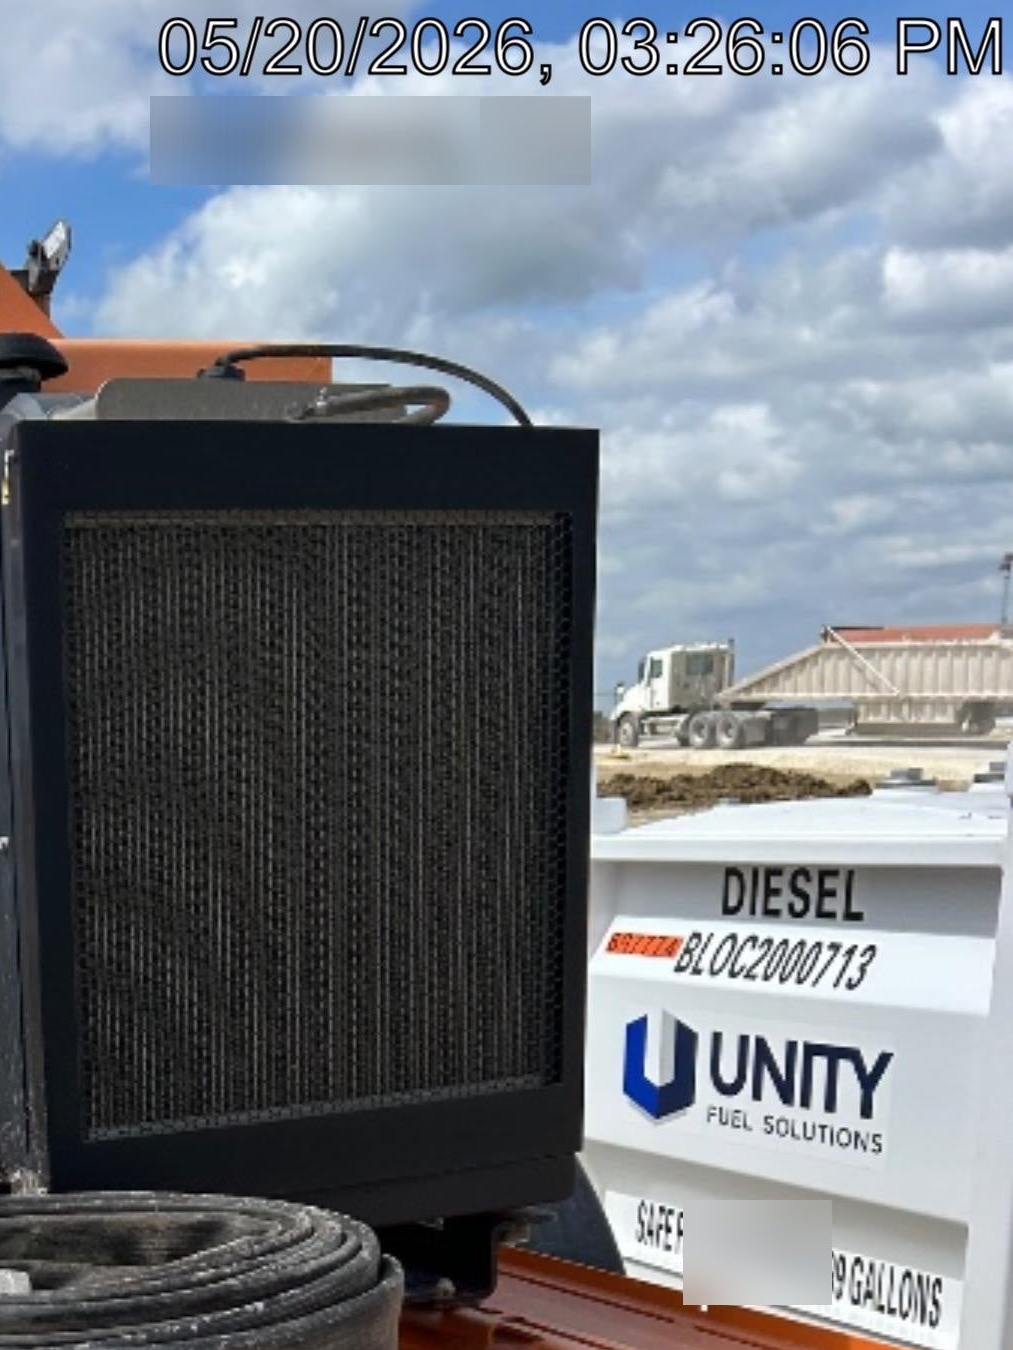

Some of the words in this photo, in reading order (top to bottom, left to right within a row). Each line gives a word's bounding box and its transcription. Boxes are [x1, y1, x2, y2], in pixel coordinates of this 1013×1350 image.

[721, 866, 864, 922] DIESEL
[673, 932, 877, 990] BLOC2000713
[710, 1031, 894, 1119] UNITY
[706, 1104, 753, 1131] FUEL
[763, 1115, 883, 1154] SOLUTIONS
[635, 1199, 673, 1251] SAFE
[849, 1255, 943, 1329] GALLONS
